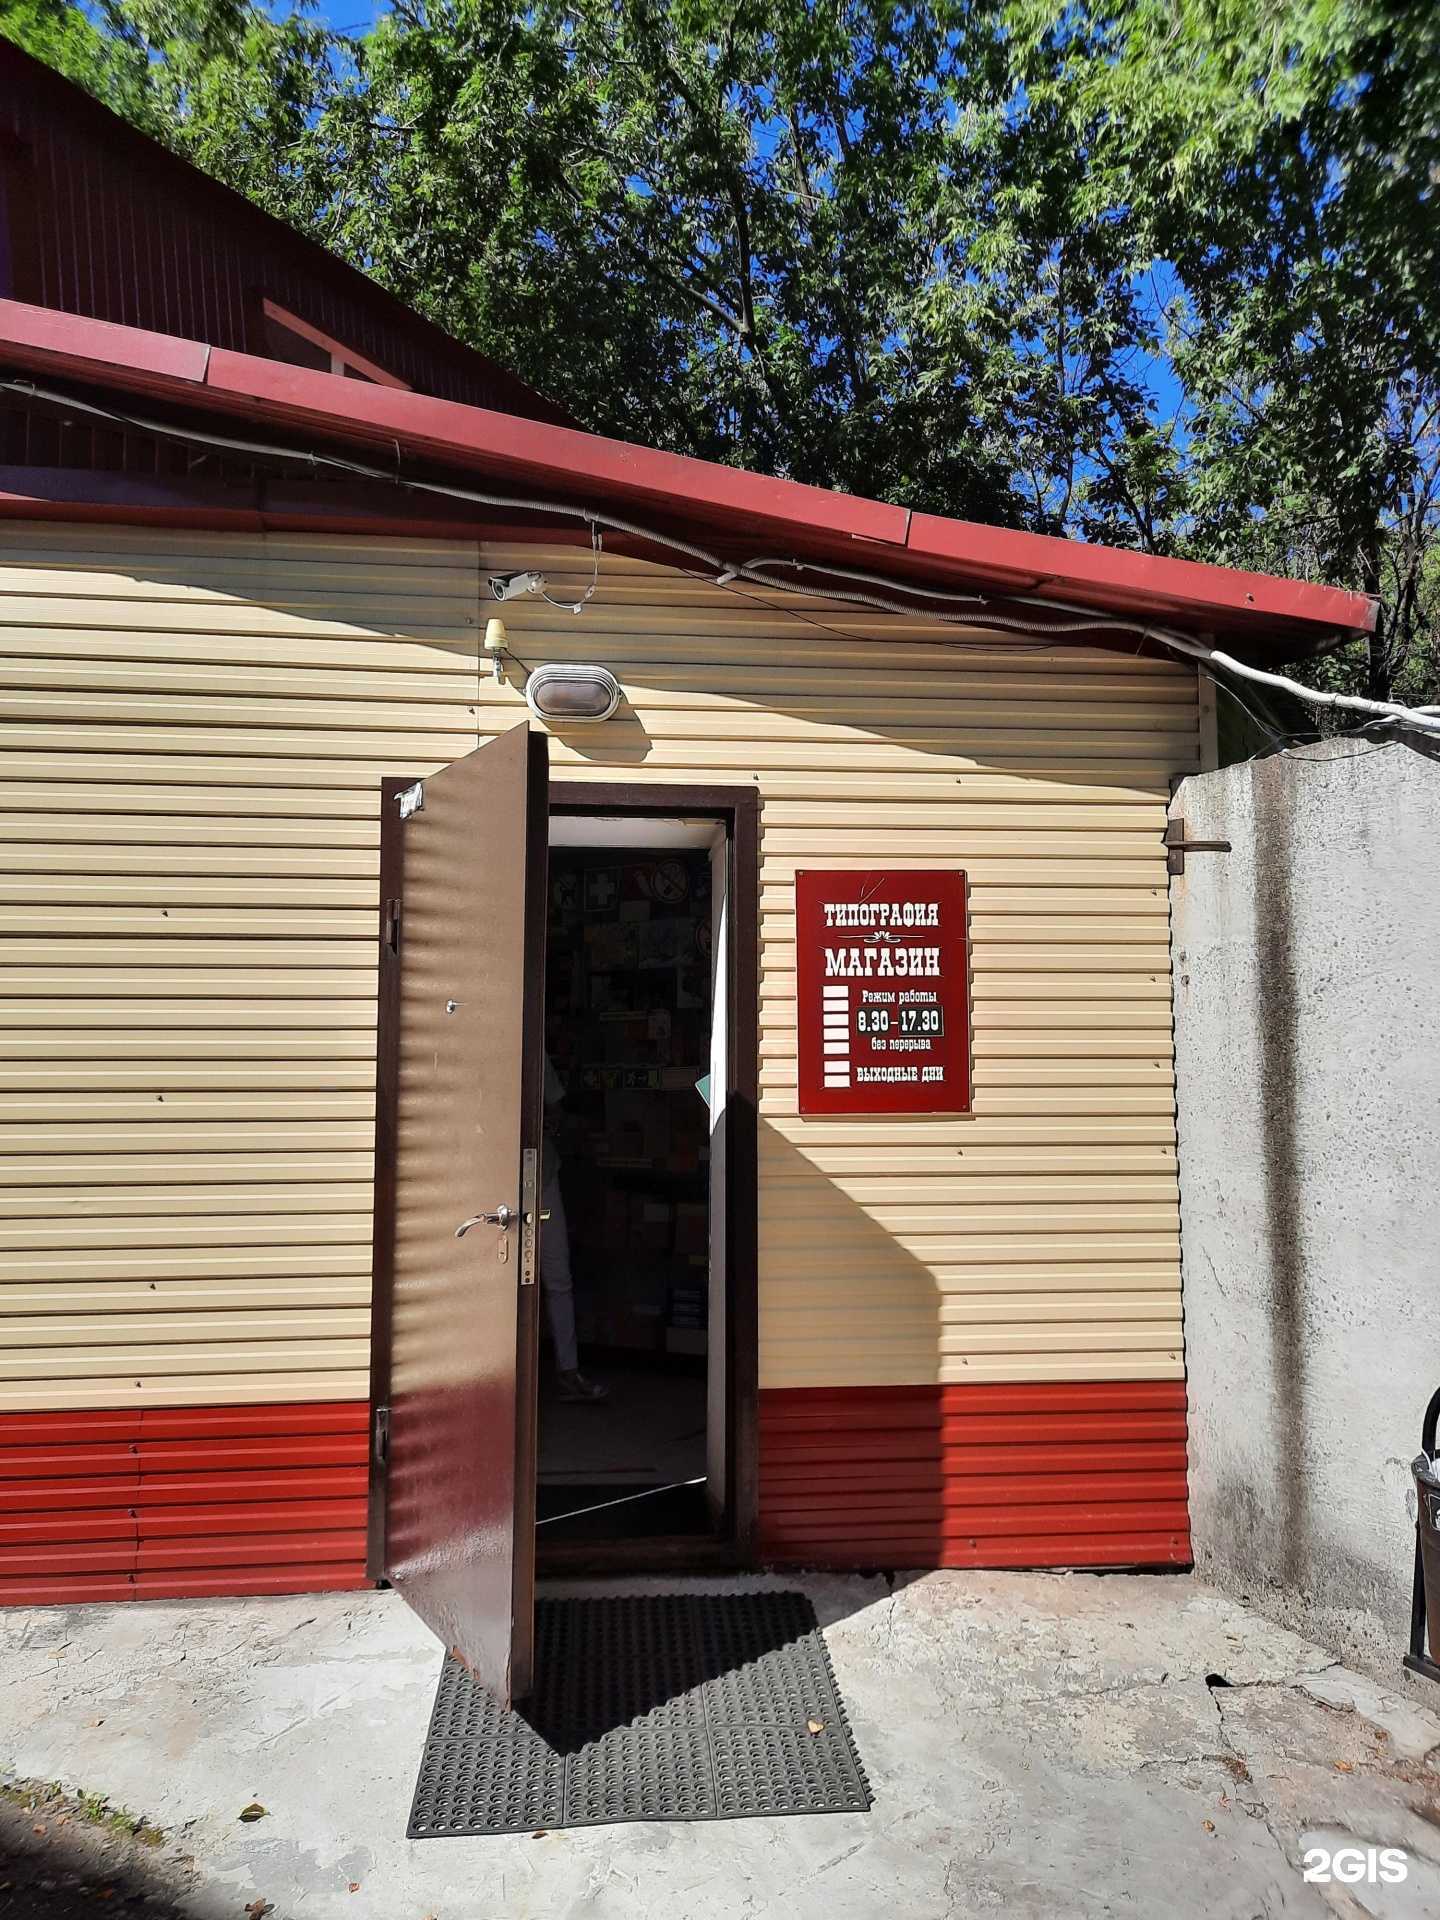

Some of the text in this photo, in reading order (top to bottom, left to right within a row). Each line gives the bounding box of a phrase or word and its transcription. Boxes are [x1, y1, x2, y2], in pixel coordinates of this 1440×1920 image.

[823, 902, 939, 927] ТИПОГРАФИЯ
[825, 947, 940, 977] МАГАЗИН
[862, 989, 937, 1005] Режим работы
[871, 1037, 931, 1052] без перерыва
[857, 1066, 944, 1083] ВЫХОДНЫЕ ДНИ
